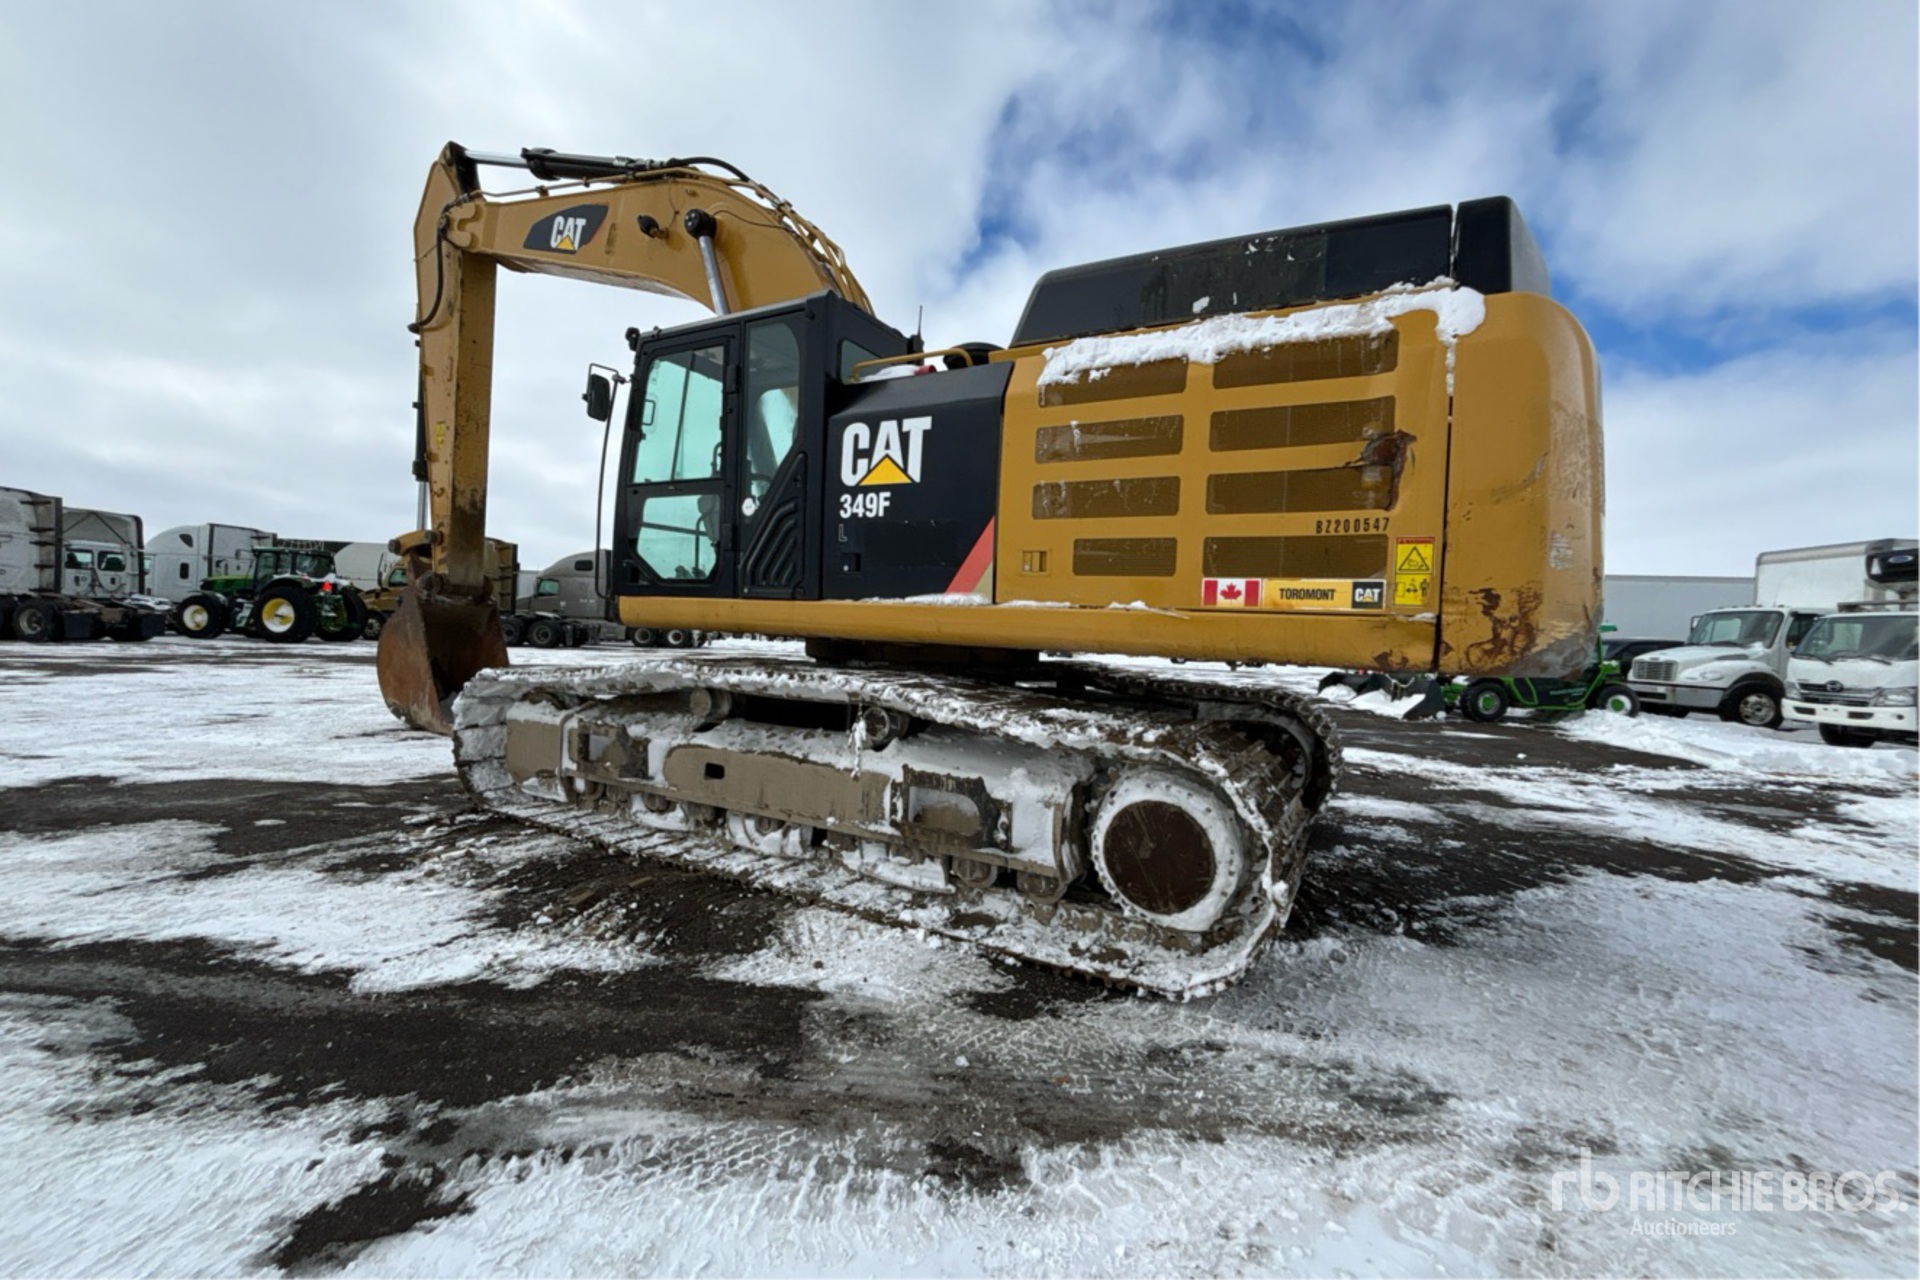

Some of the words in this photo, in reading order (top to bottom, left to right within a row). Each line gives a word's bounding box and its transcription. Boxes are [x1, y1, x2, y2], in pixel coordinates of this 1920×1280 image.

[551, 215, 587, 250] CAT
[841, 416, 932, 487] CAT
[839, 491, 891, 519] 349F
[1316, 517, 1390, 534] BZ200547
[1279, 587, 1336, 601] TOROMONT
[1355, 588, 1381, 602] CAT
